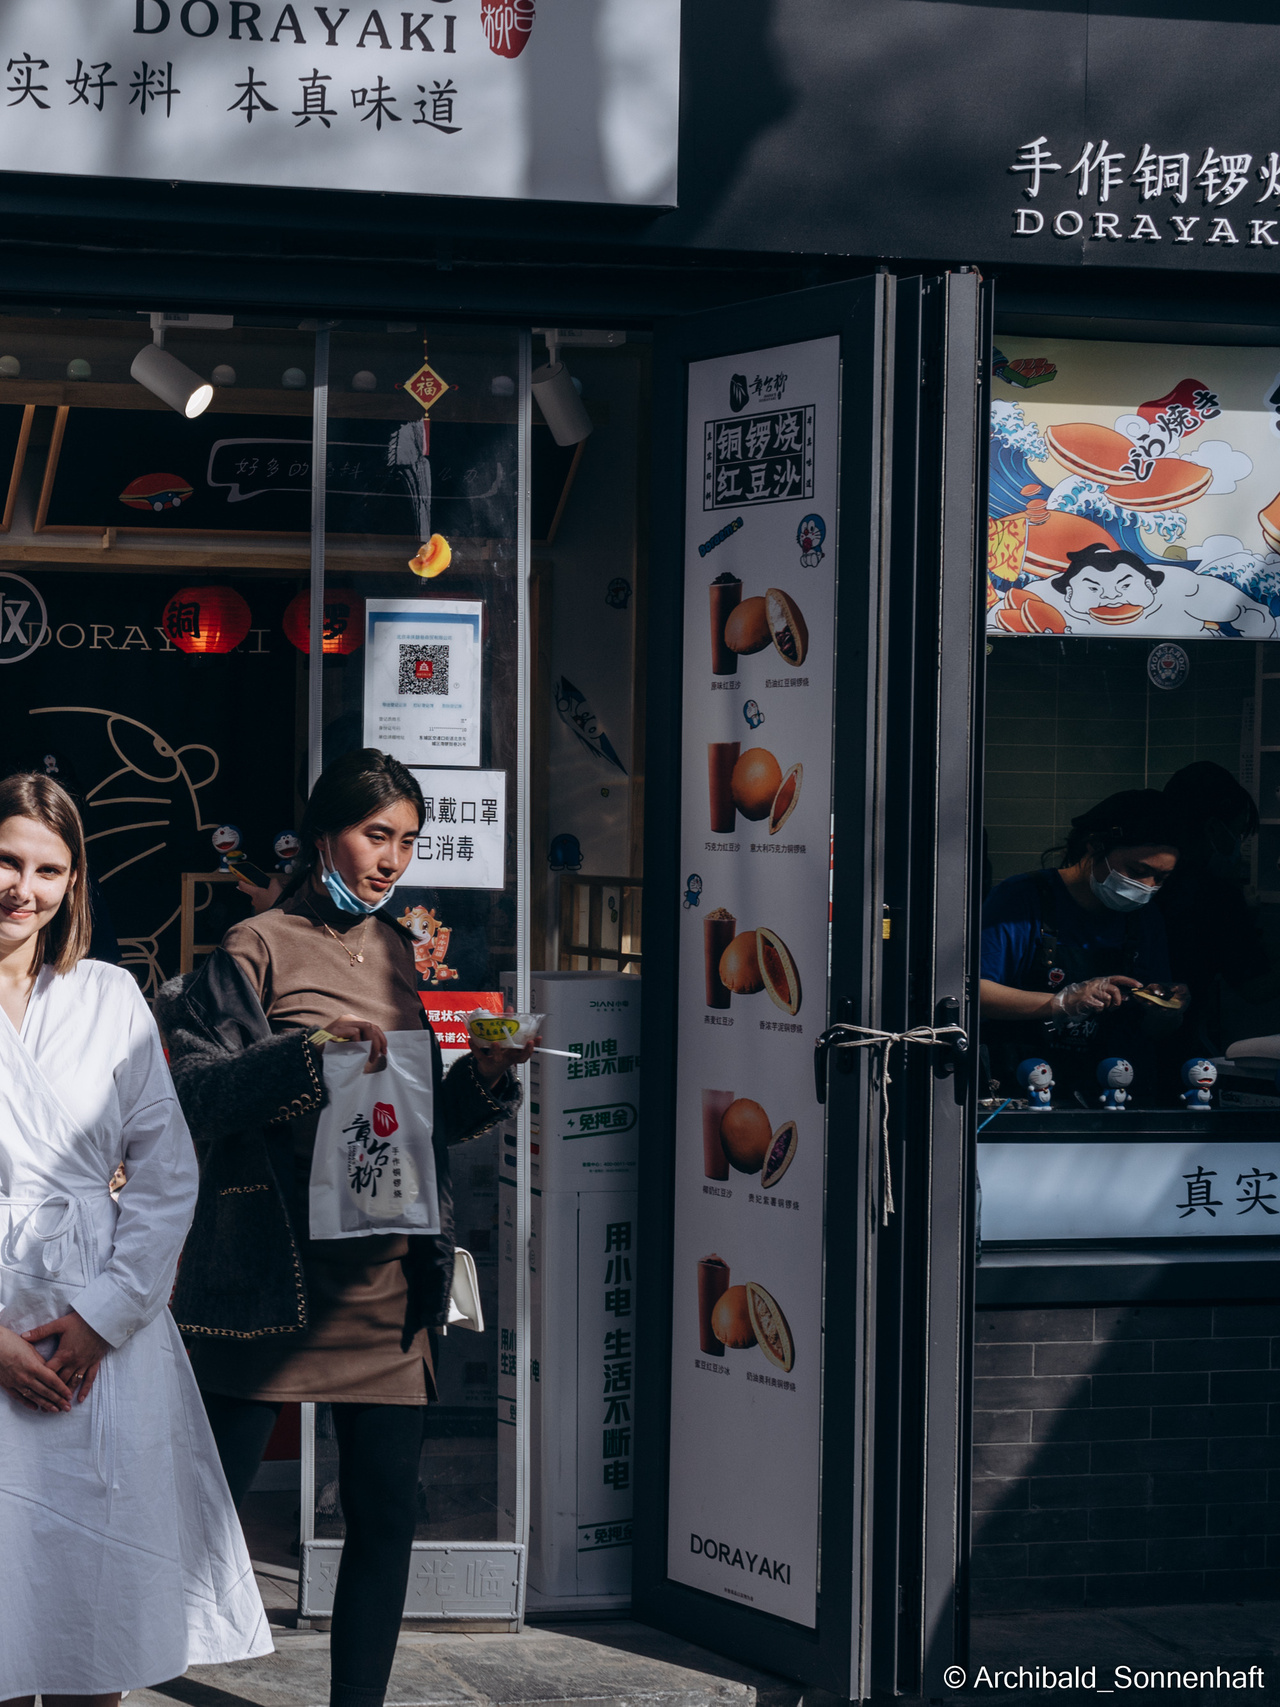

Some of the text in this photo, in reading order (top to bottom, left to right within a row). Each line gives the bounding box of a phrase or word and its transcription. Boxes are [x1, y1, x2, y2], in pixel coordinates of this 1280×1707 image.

[133, 0, 458, 54] DORAYAKI
[226, 66, 463, 134] 本真味道
[1014, 208, 1279, 247] DORAYAK
[416, 377, 436, 397] 福
[717, 413, 804, 461] 铜锣烧
[1120, 390, 1222, 481] どら焼き
[717, 459, 802, 501] 红豆沙
[25, 622, 272, 654] DORAYI
[167, 602, 201, 639] 铜
[417, 835, 474, 862] 已消毒
[434, 1032, 471, 1044] 承诺公
[568, 1038, 618, 1062] 用小电
[580, 1109, 628, 1131] 免押金
[342, 1113, 391, 1198] 章台柳
[391, 1146, 402, 1199] 手作铜锣烧
[1176, 1165, 1280, 1219] 真实
[603, 1221, 632, 1491] 用小电 生活不断电
[690, 1533, 791, 1585] DORAYAKI
